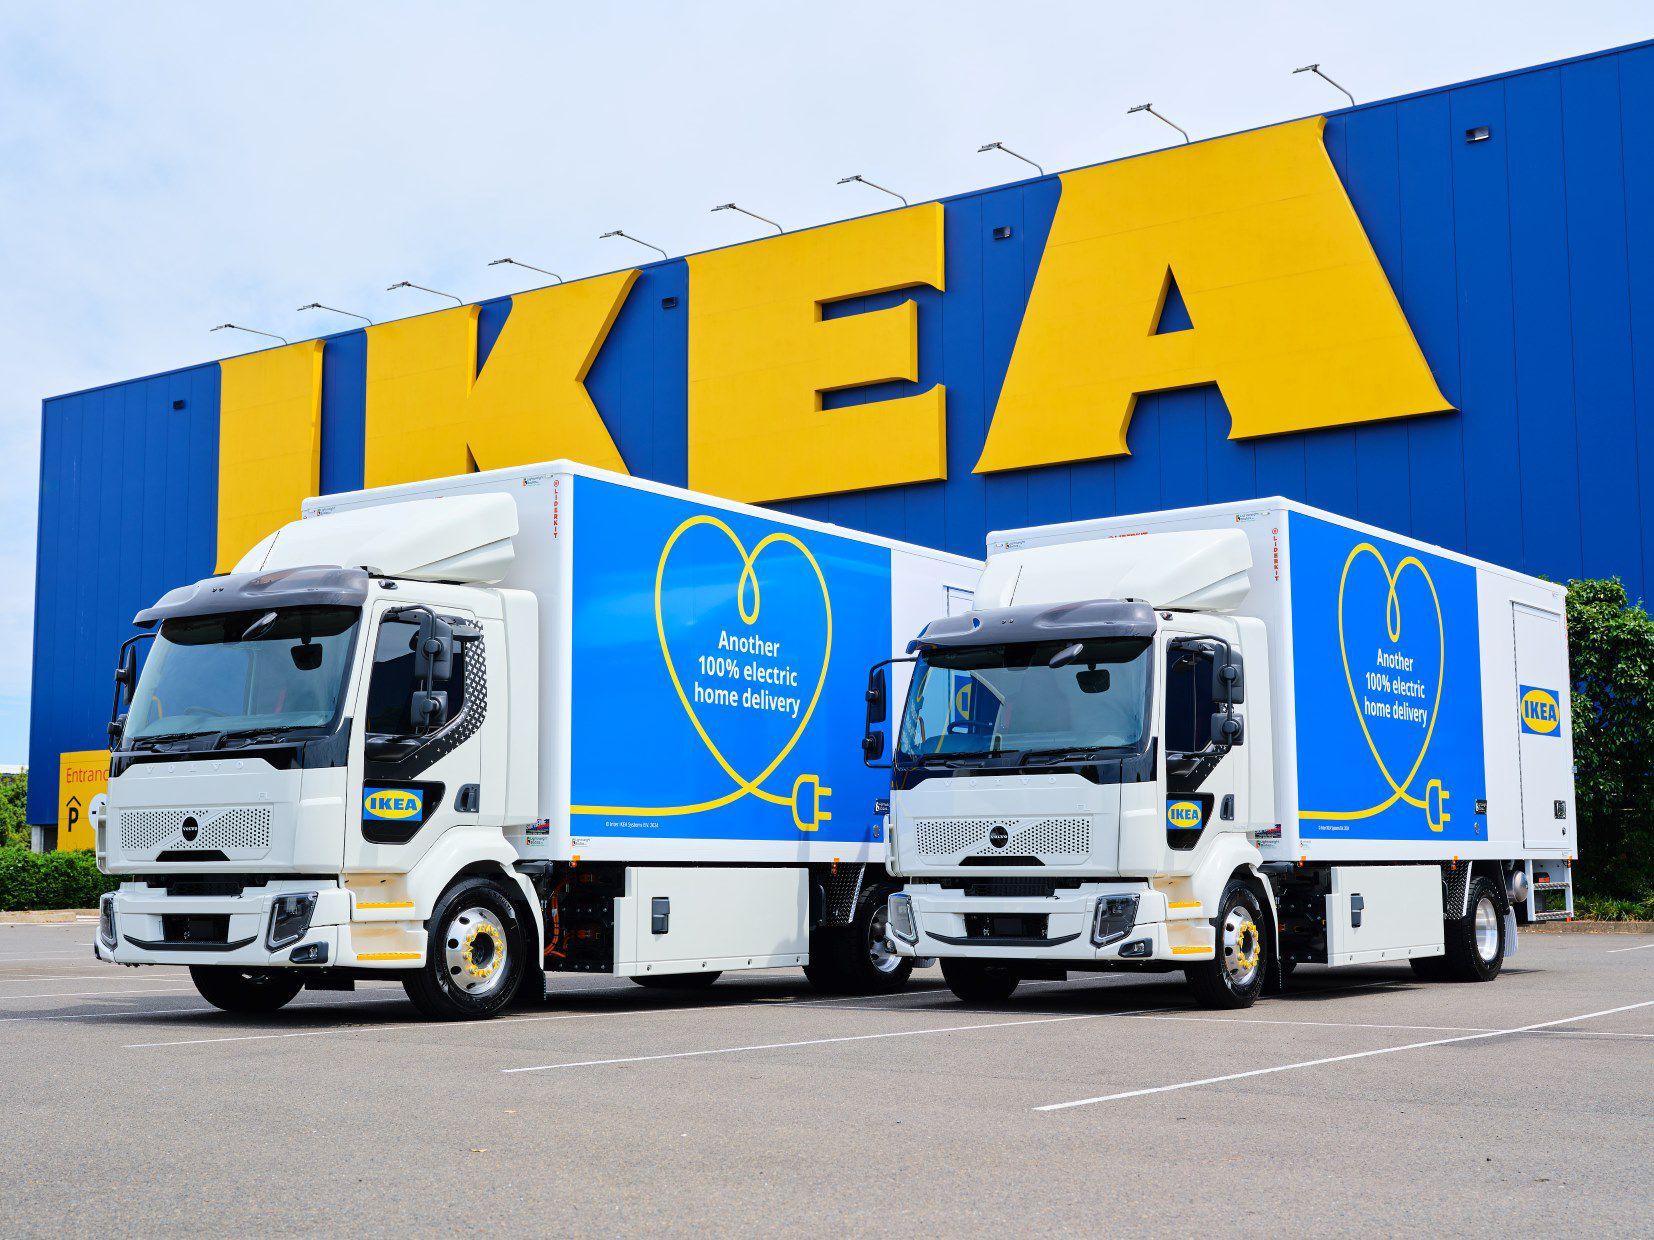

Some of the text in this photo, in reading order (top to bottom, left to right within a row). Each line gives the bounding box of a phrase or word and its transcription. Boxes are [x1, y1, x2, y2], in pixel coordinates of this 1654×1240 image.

[214, 115, 1459, 576] IKEA
[718, 630, 780, 657] Another
[698, 655, 798, 687] 100% electric
[1376, 648, 1414, 672] Another
[1365, 671, 1426, 699] 100% electric
[694, 681, 801, 719] home delivery
[1364, 695, 1428, 729] home delivery
[1524, 699, 1558, 723] IKEA
[66, 767, 109, 784] Entranc
[370, 797, 418, 811] IKEA
[1170, 808, 1199, 821] IKEA
